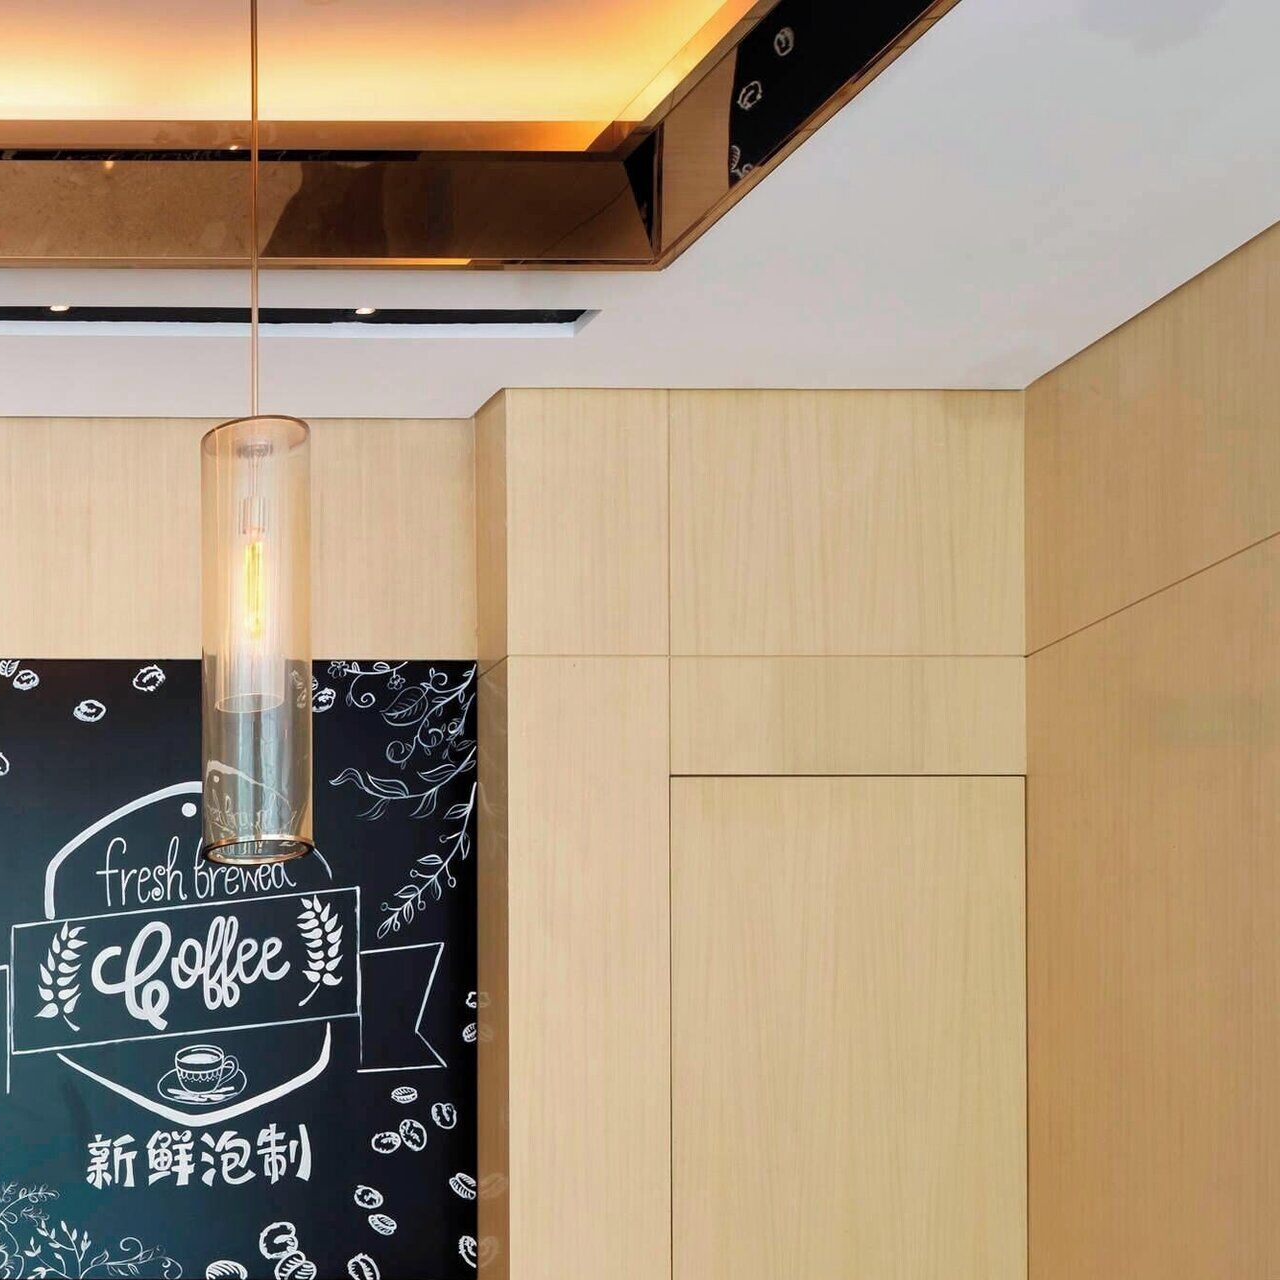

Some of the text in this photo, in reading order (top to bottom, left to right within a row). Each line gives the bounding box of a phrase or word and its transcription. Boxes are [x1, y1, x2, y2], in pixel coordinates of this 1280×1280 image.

[96, 835, 188, 907] fresh
[91, 915, 291, 1030] Coffee
[86, 1123, 312, 1189] 新鲜泡制
